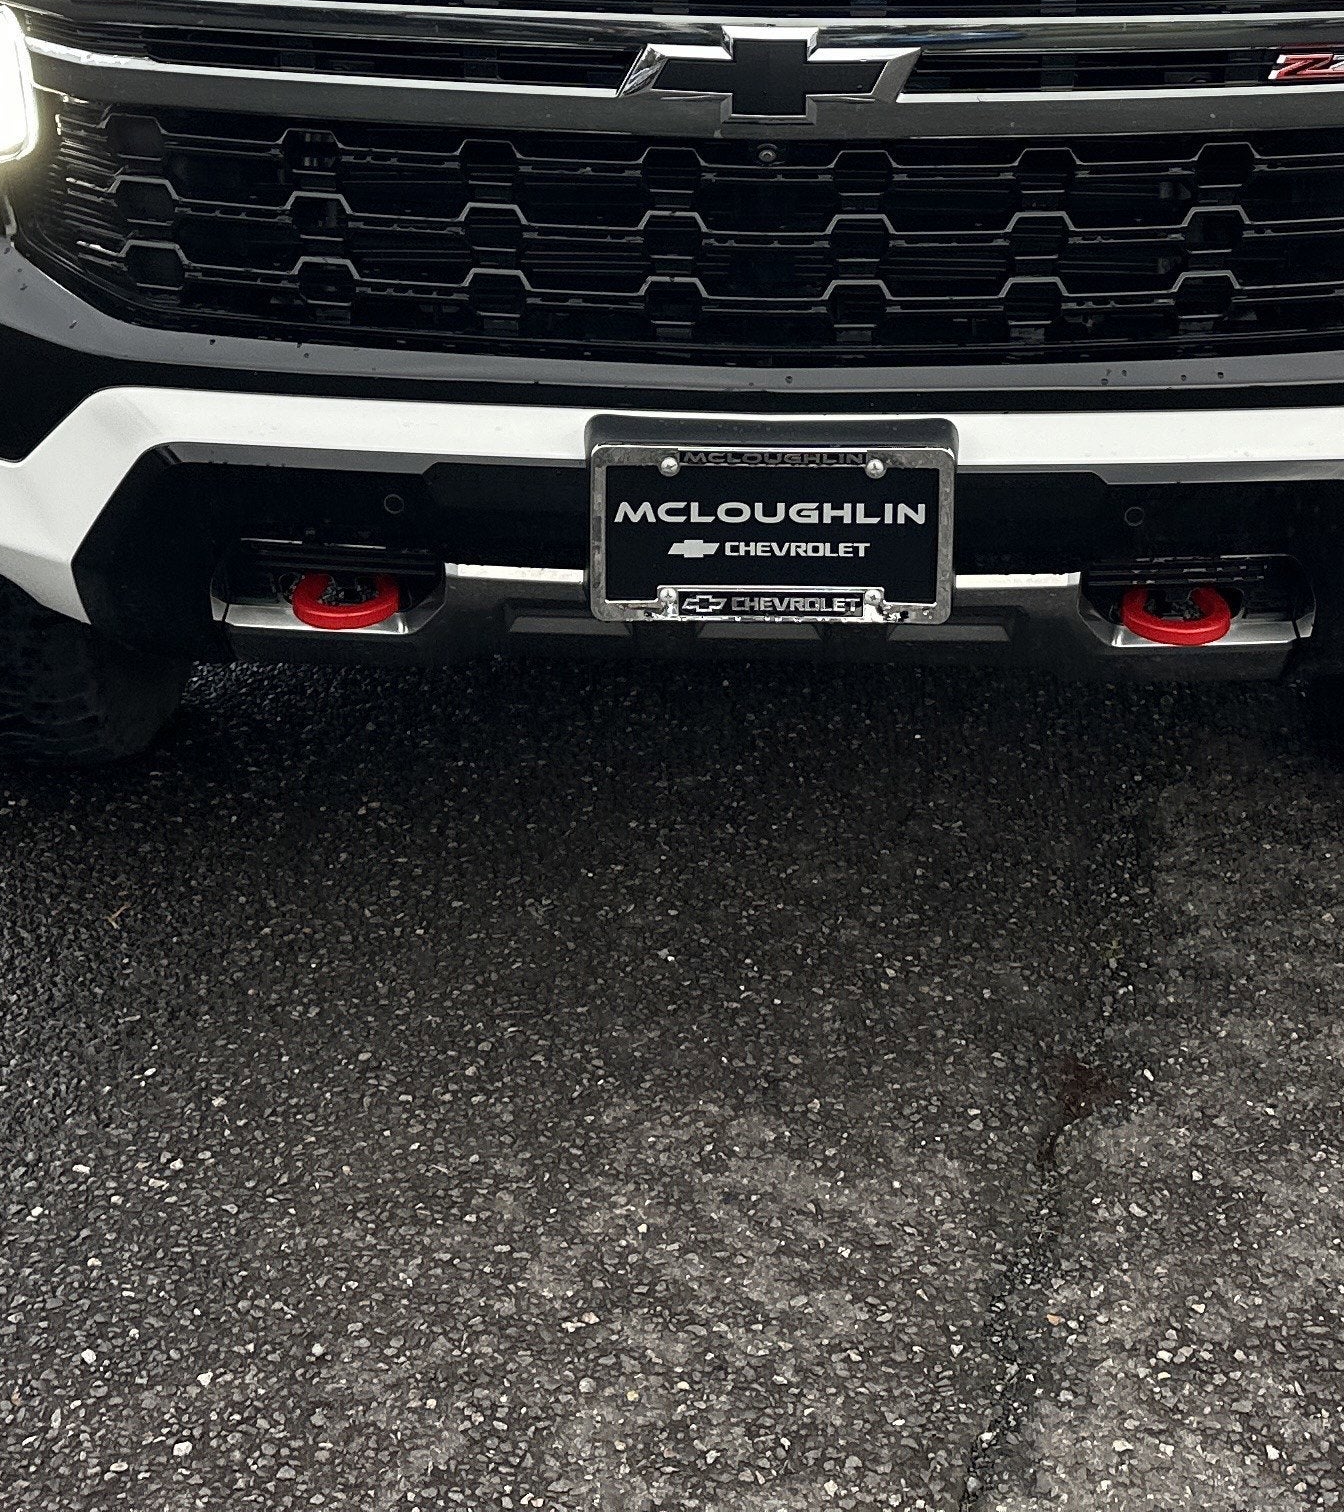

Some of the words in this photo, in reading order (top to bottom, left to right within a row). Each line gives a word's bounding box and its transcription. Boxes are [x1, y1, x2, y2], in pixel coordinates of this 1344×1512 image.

[682, 450, 866, 466] MCLOUGHLIN
[613, 500, 926, 526] MCLOUGHLIN
[723, 540, 871, 558] CHEVROLET
[730, 594, 861, 614] CHEVROLET
